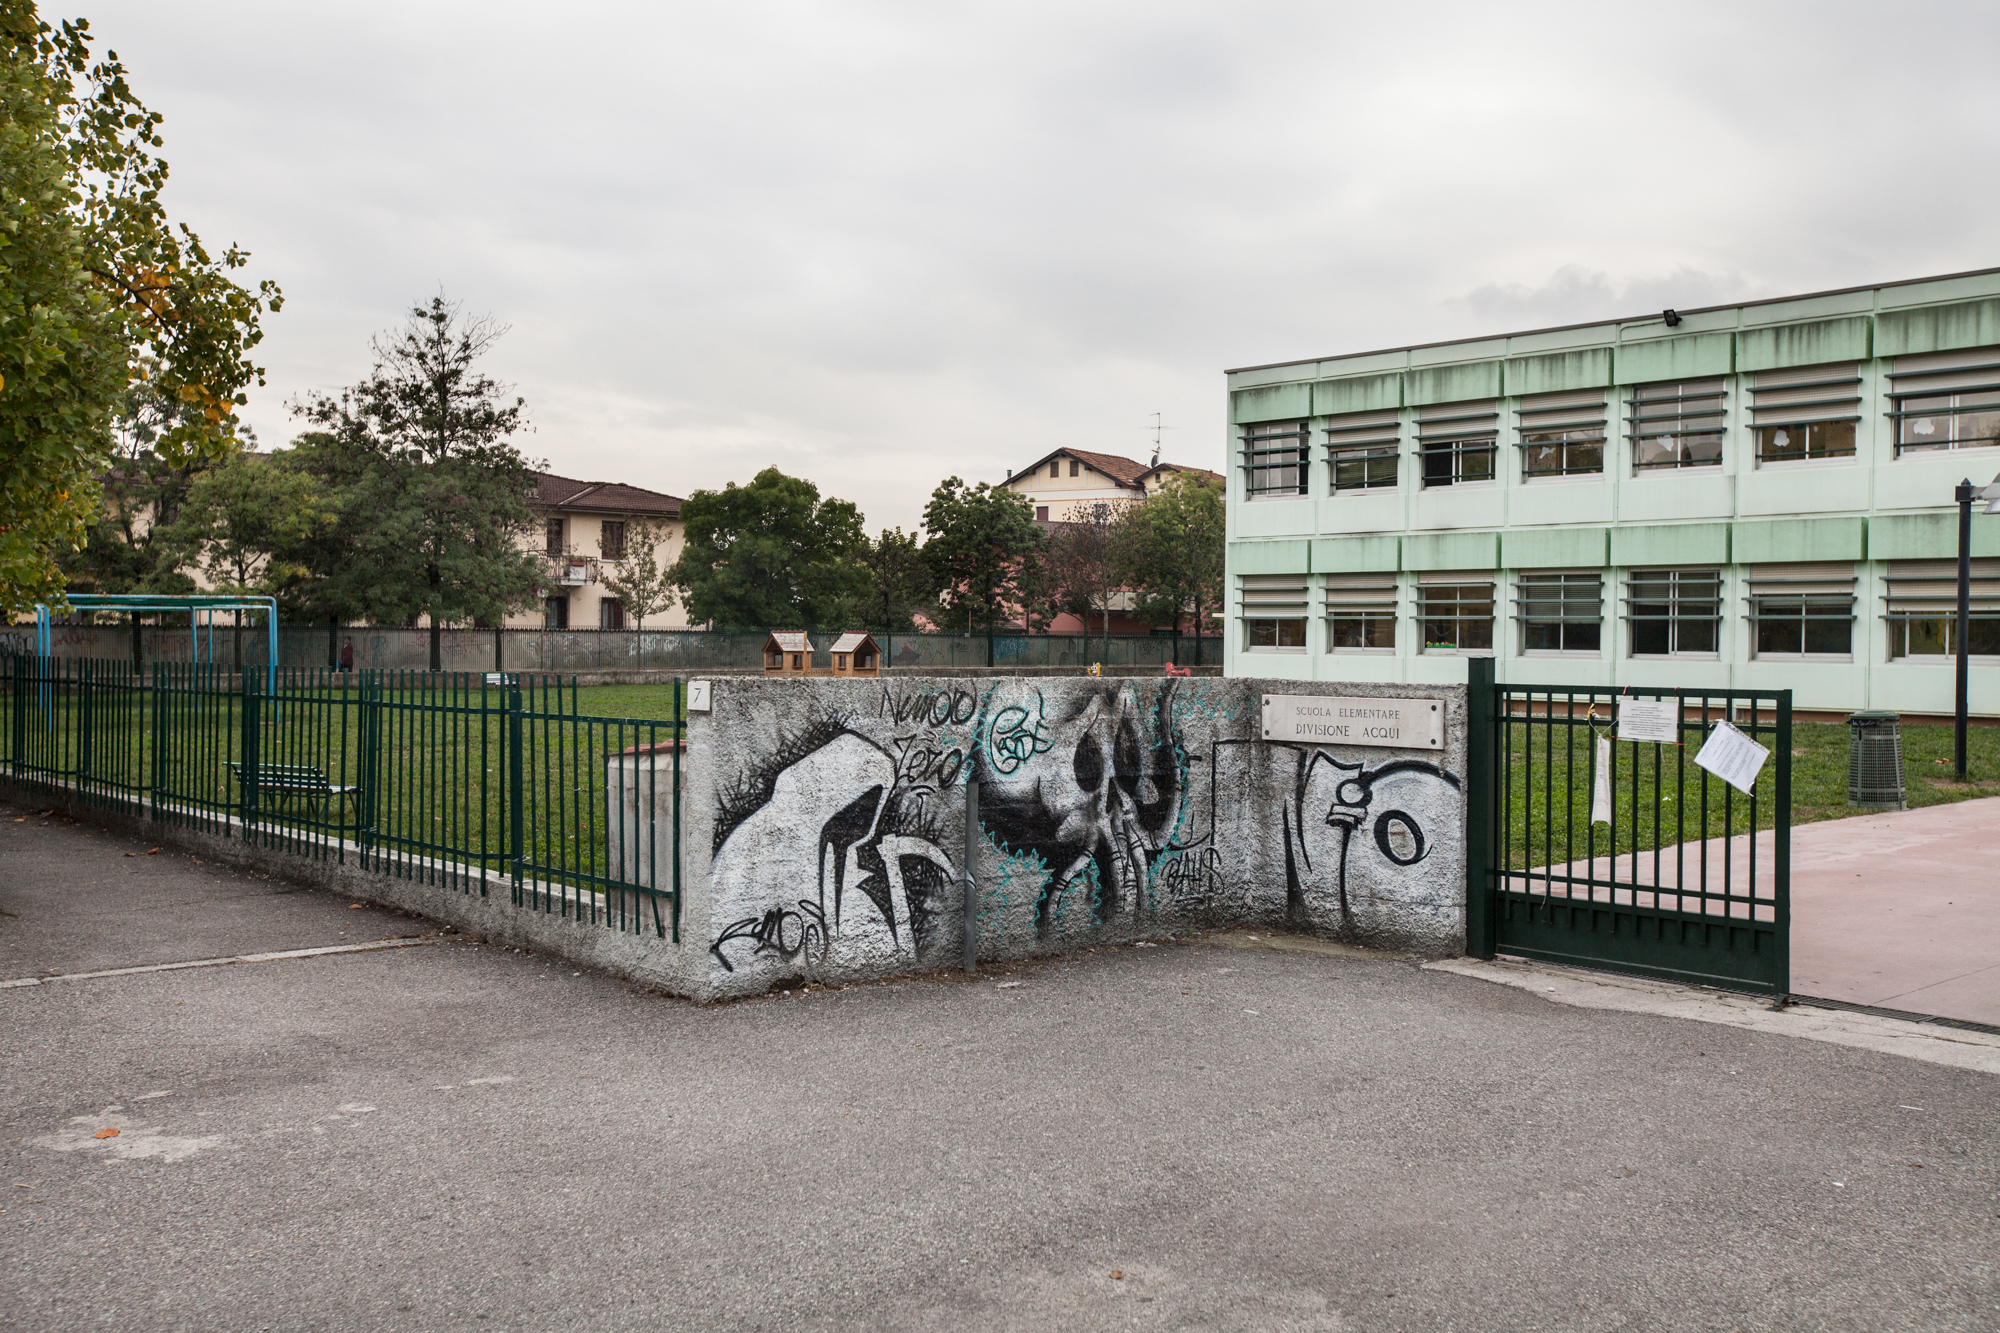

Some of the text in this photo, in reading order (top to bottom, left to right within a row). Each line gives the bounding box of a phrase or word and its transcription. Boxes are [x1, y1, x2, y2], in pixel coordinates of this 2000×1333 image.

[694, 687, 702, 703] 7
[1296, 706, 1400, 720] SCUOLA ELEMENTARE
[1296, 723, 1400, 739] DIVISIONE ACQUI
